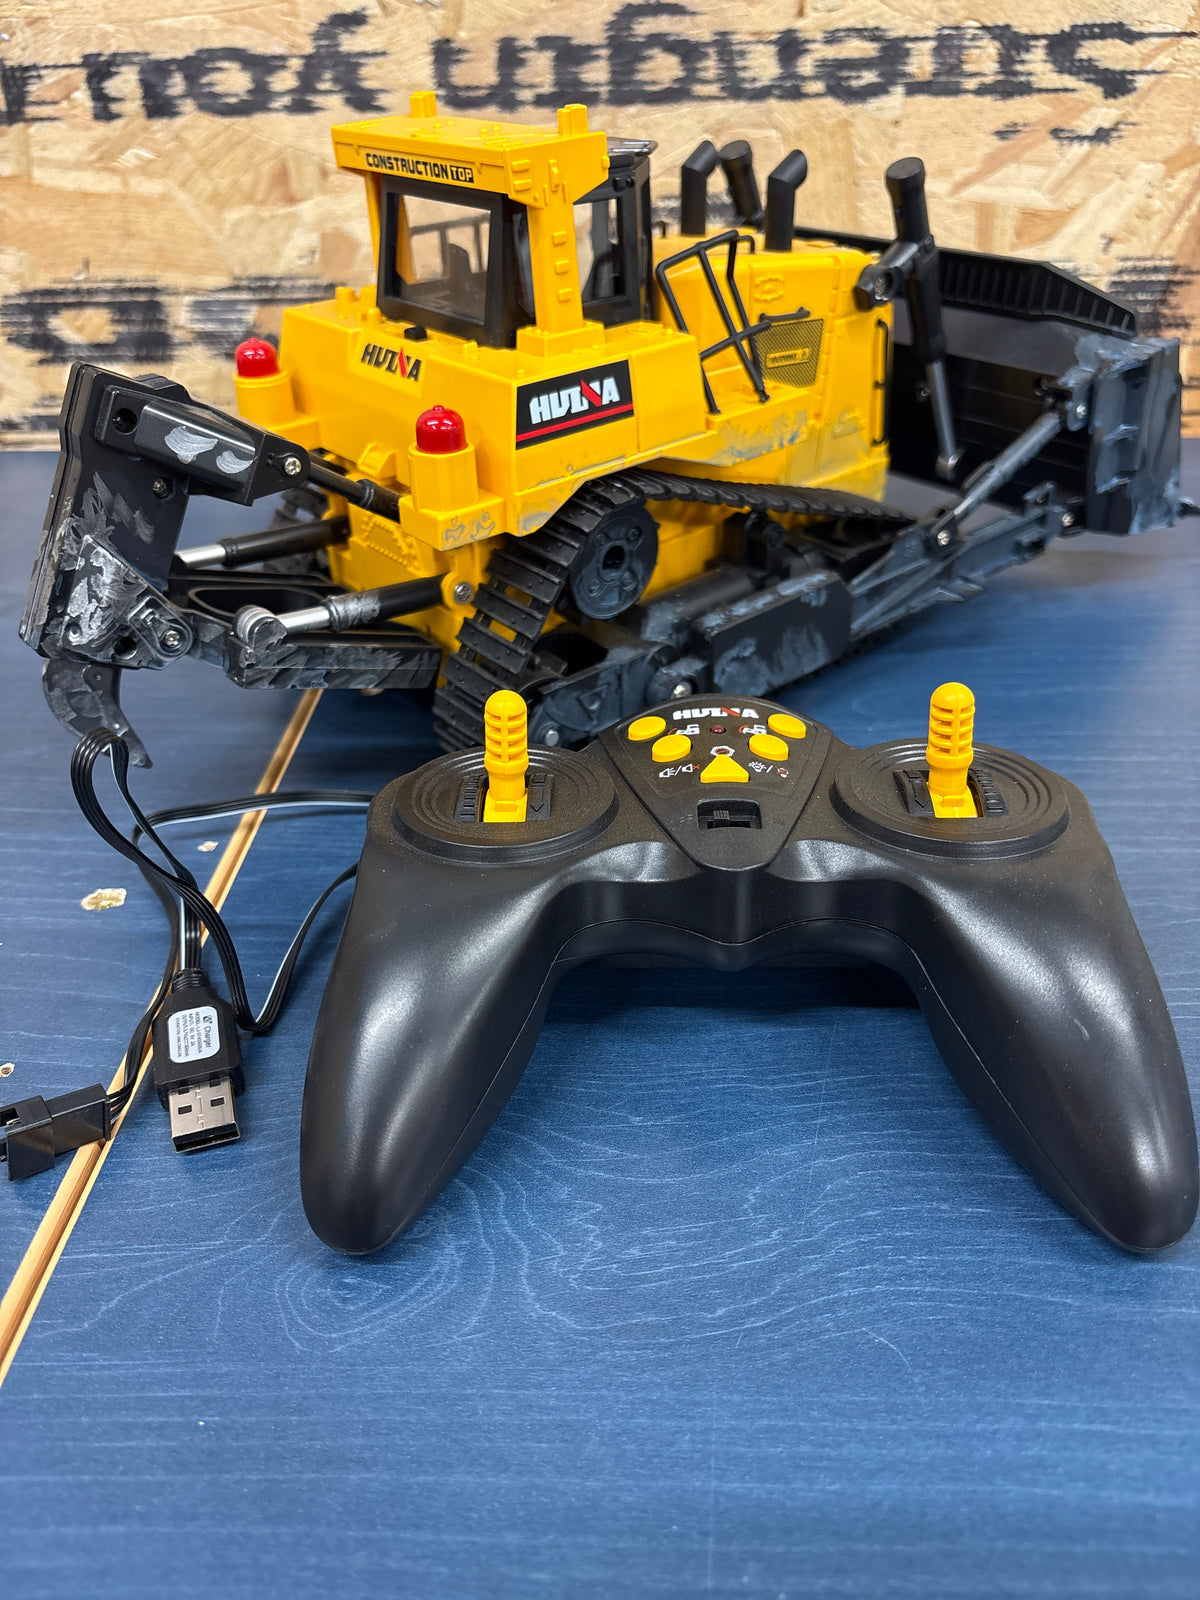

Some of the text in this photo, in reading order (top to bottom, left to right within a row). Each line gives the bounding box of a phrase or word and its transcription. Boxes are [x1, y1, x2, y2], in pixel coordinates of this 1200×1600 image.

[365, 152, 473, 182] CONSTRUCTION TOP
[529, 376, 620, 425] HUINA
[204, 1026, 212, 1048] Charger
